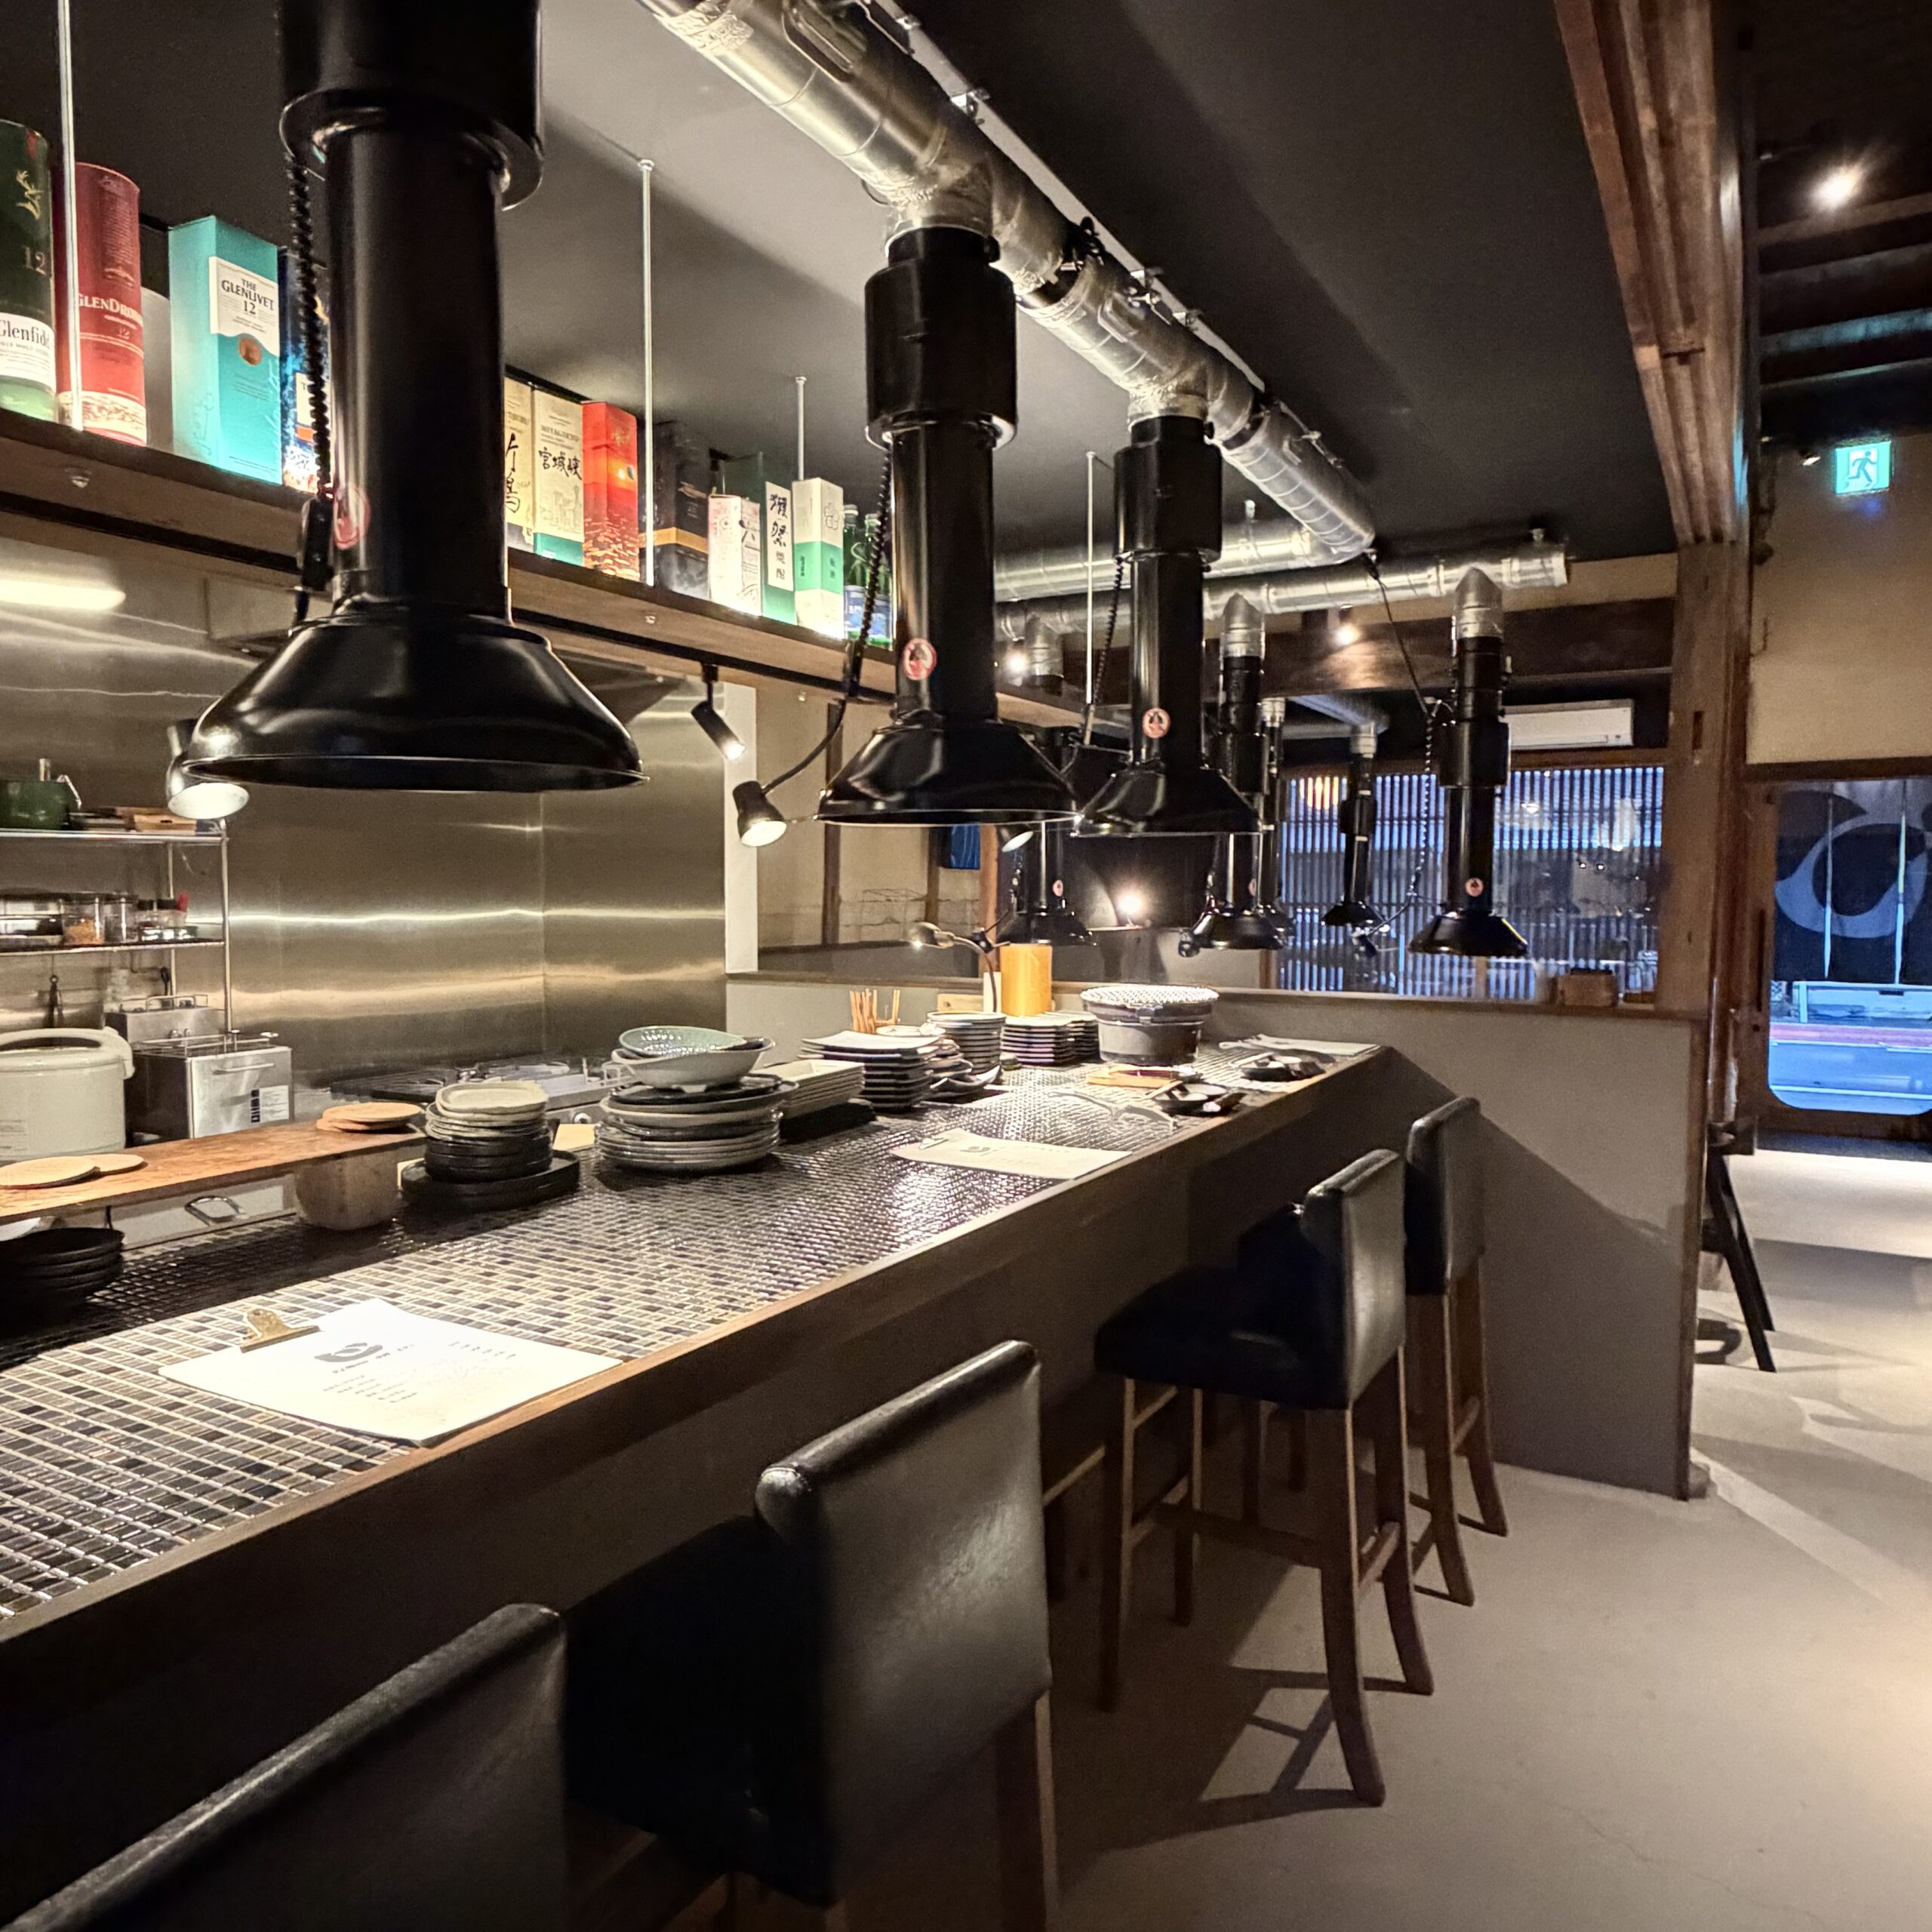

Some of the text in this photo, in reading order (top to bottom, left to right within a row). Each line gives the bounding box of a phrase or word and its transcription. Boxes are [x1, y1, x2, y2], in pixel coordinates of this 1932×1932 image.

[23, 245, 46, 276] 12
[221, 280, 274, 311] GLENLIVET
[242, 278, 257, 291] THE
[244, 300, 256, 315] 12
